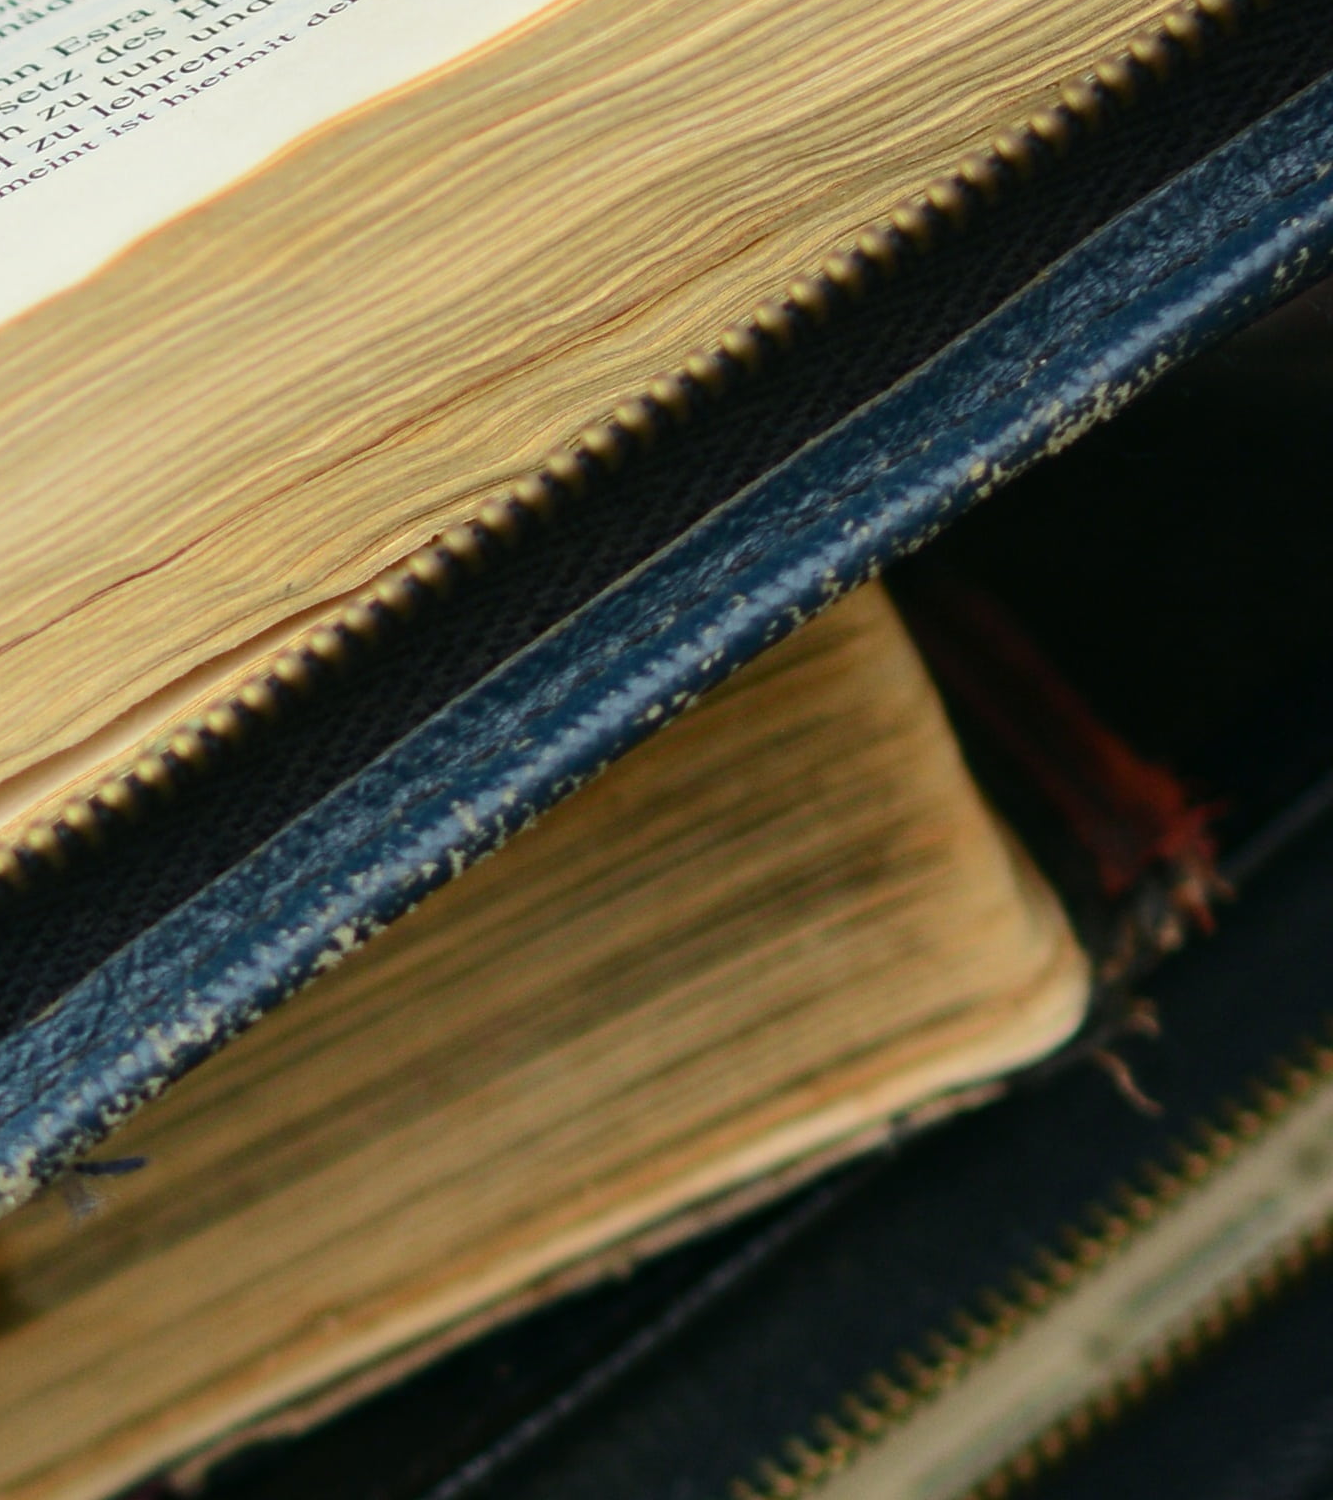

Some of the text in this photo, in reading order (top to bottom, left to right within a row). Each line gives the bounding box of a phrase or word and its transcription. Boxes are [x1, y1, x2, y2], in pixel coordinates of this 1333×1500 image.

[51, 8, 155, 58] Esra
[94, 25, 168, 66] des
[25, 122, 83, 155] zu
[88, 41, 246, 119] lehren.
[35, 91, 92, 123] zu
[100, 47, 180, 88] tun
[104, 111, 156, 139] ist
[158, 34, 297, 109] hiermit
